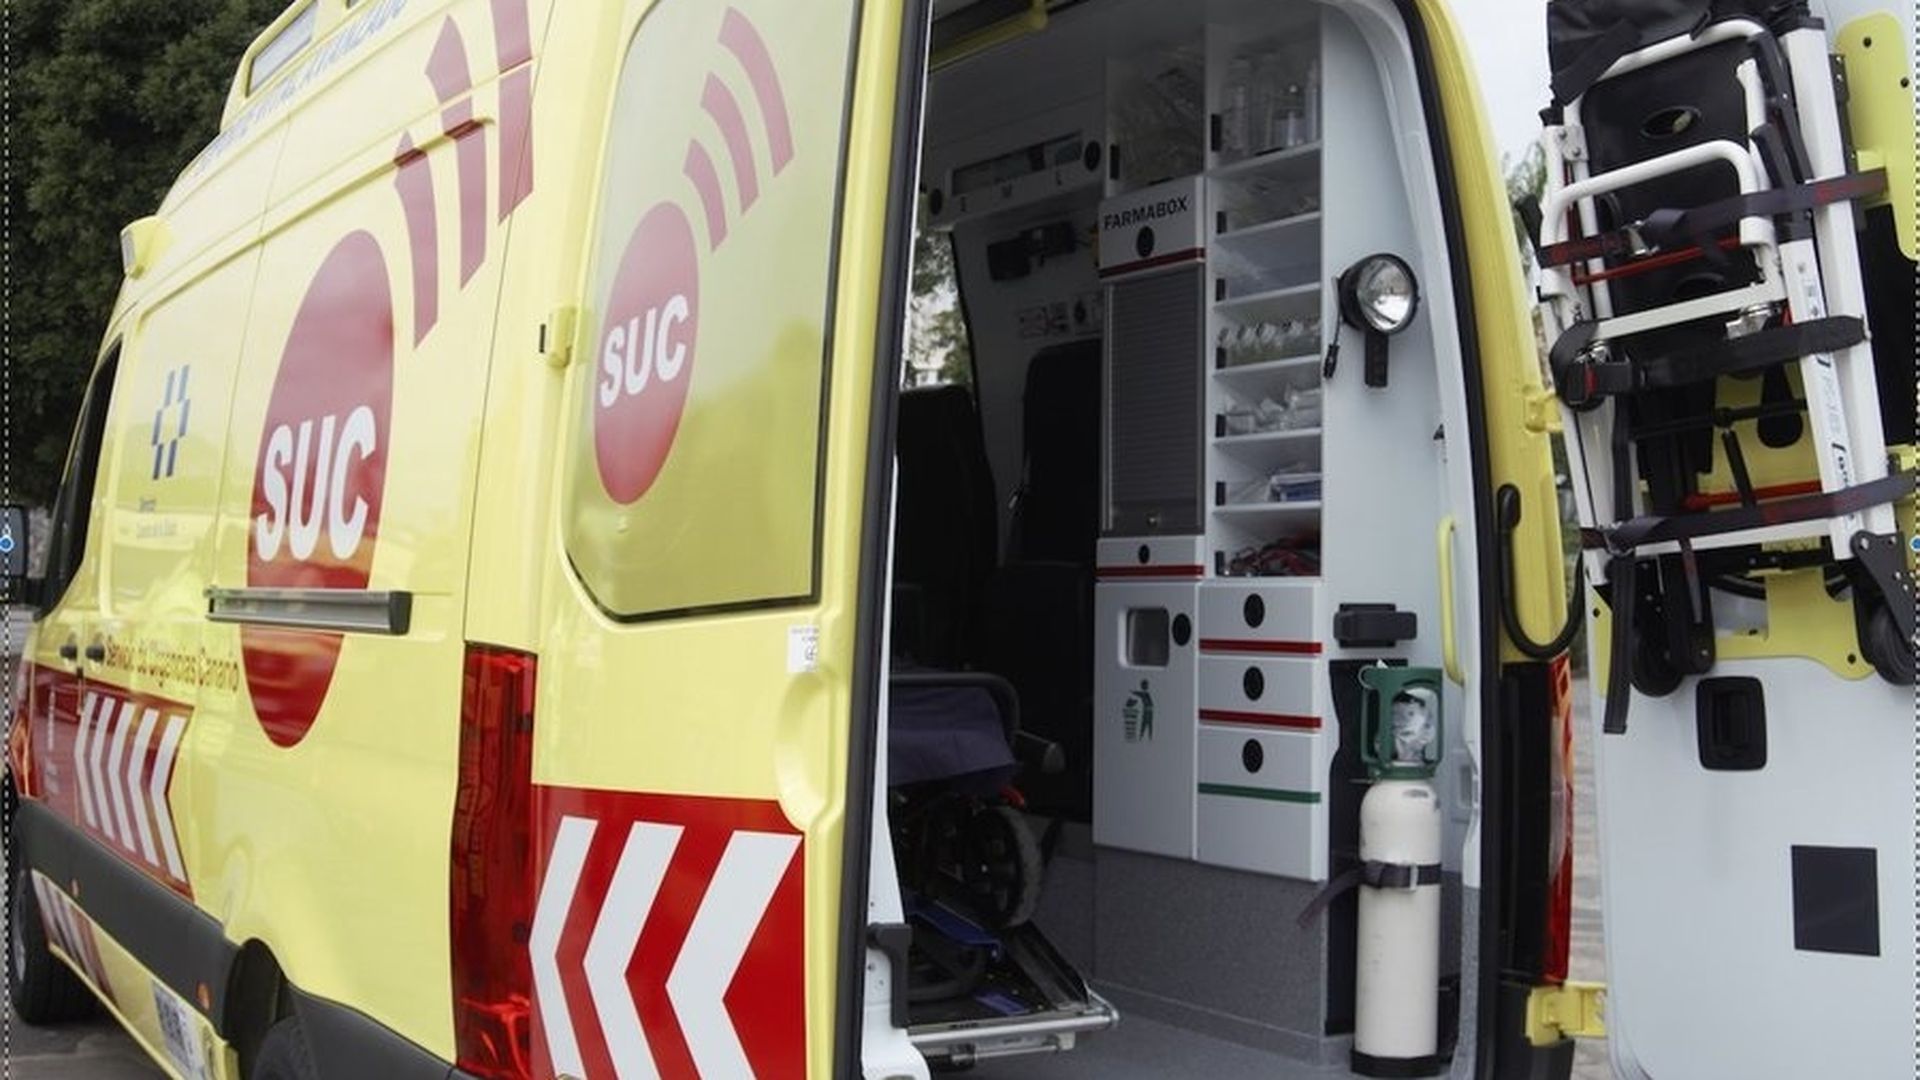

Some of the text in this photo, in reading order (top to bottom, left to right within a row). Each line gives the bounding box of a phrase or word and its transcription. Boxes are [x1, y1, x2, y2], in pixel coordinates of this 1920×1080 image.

[1103, 195, 1188, 230] FARMABOX
[600, 293, 688, 408] SUC
[256, 405, 376, 562] SUC
